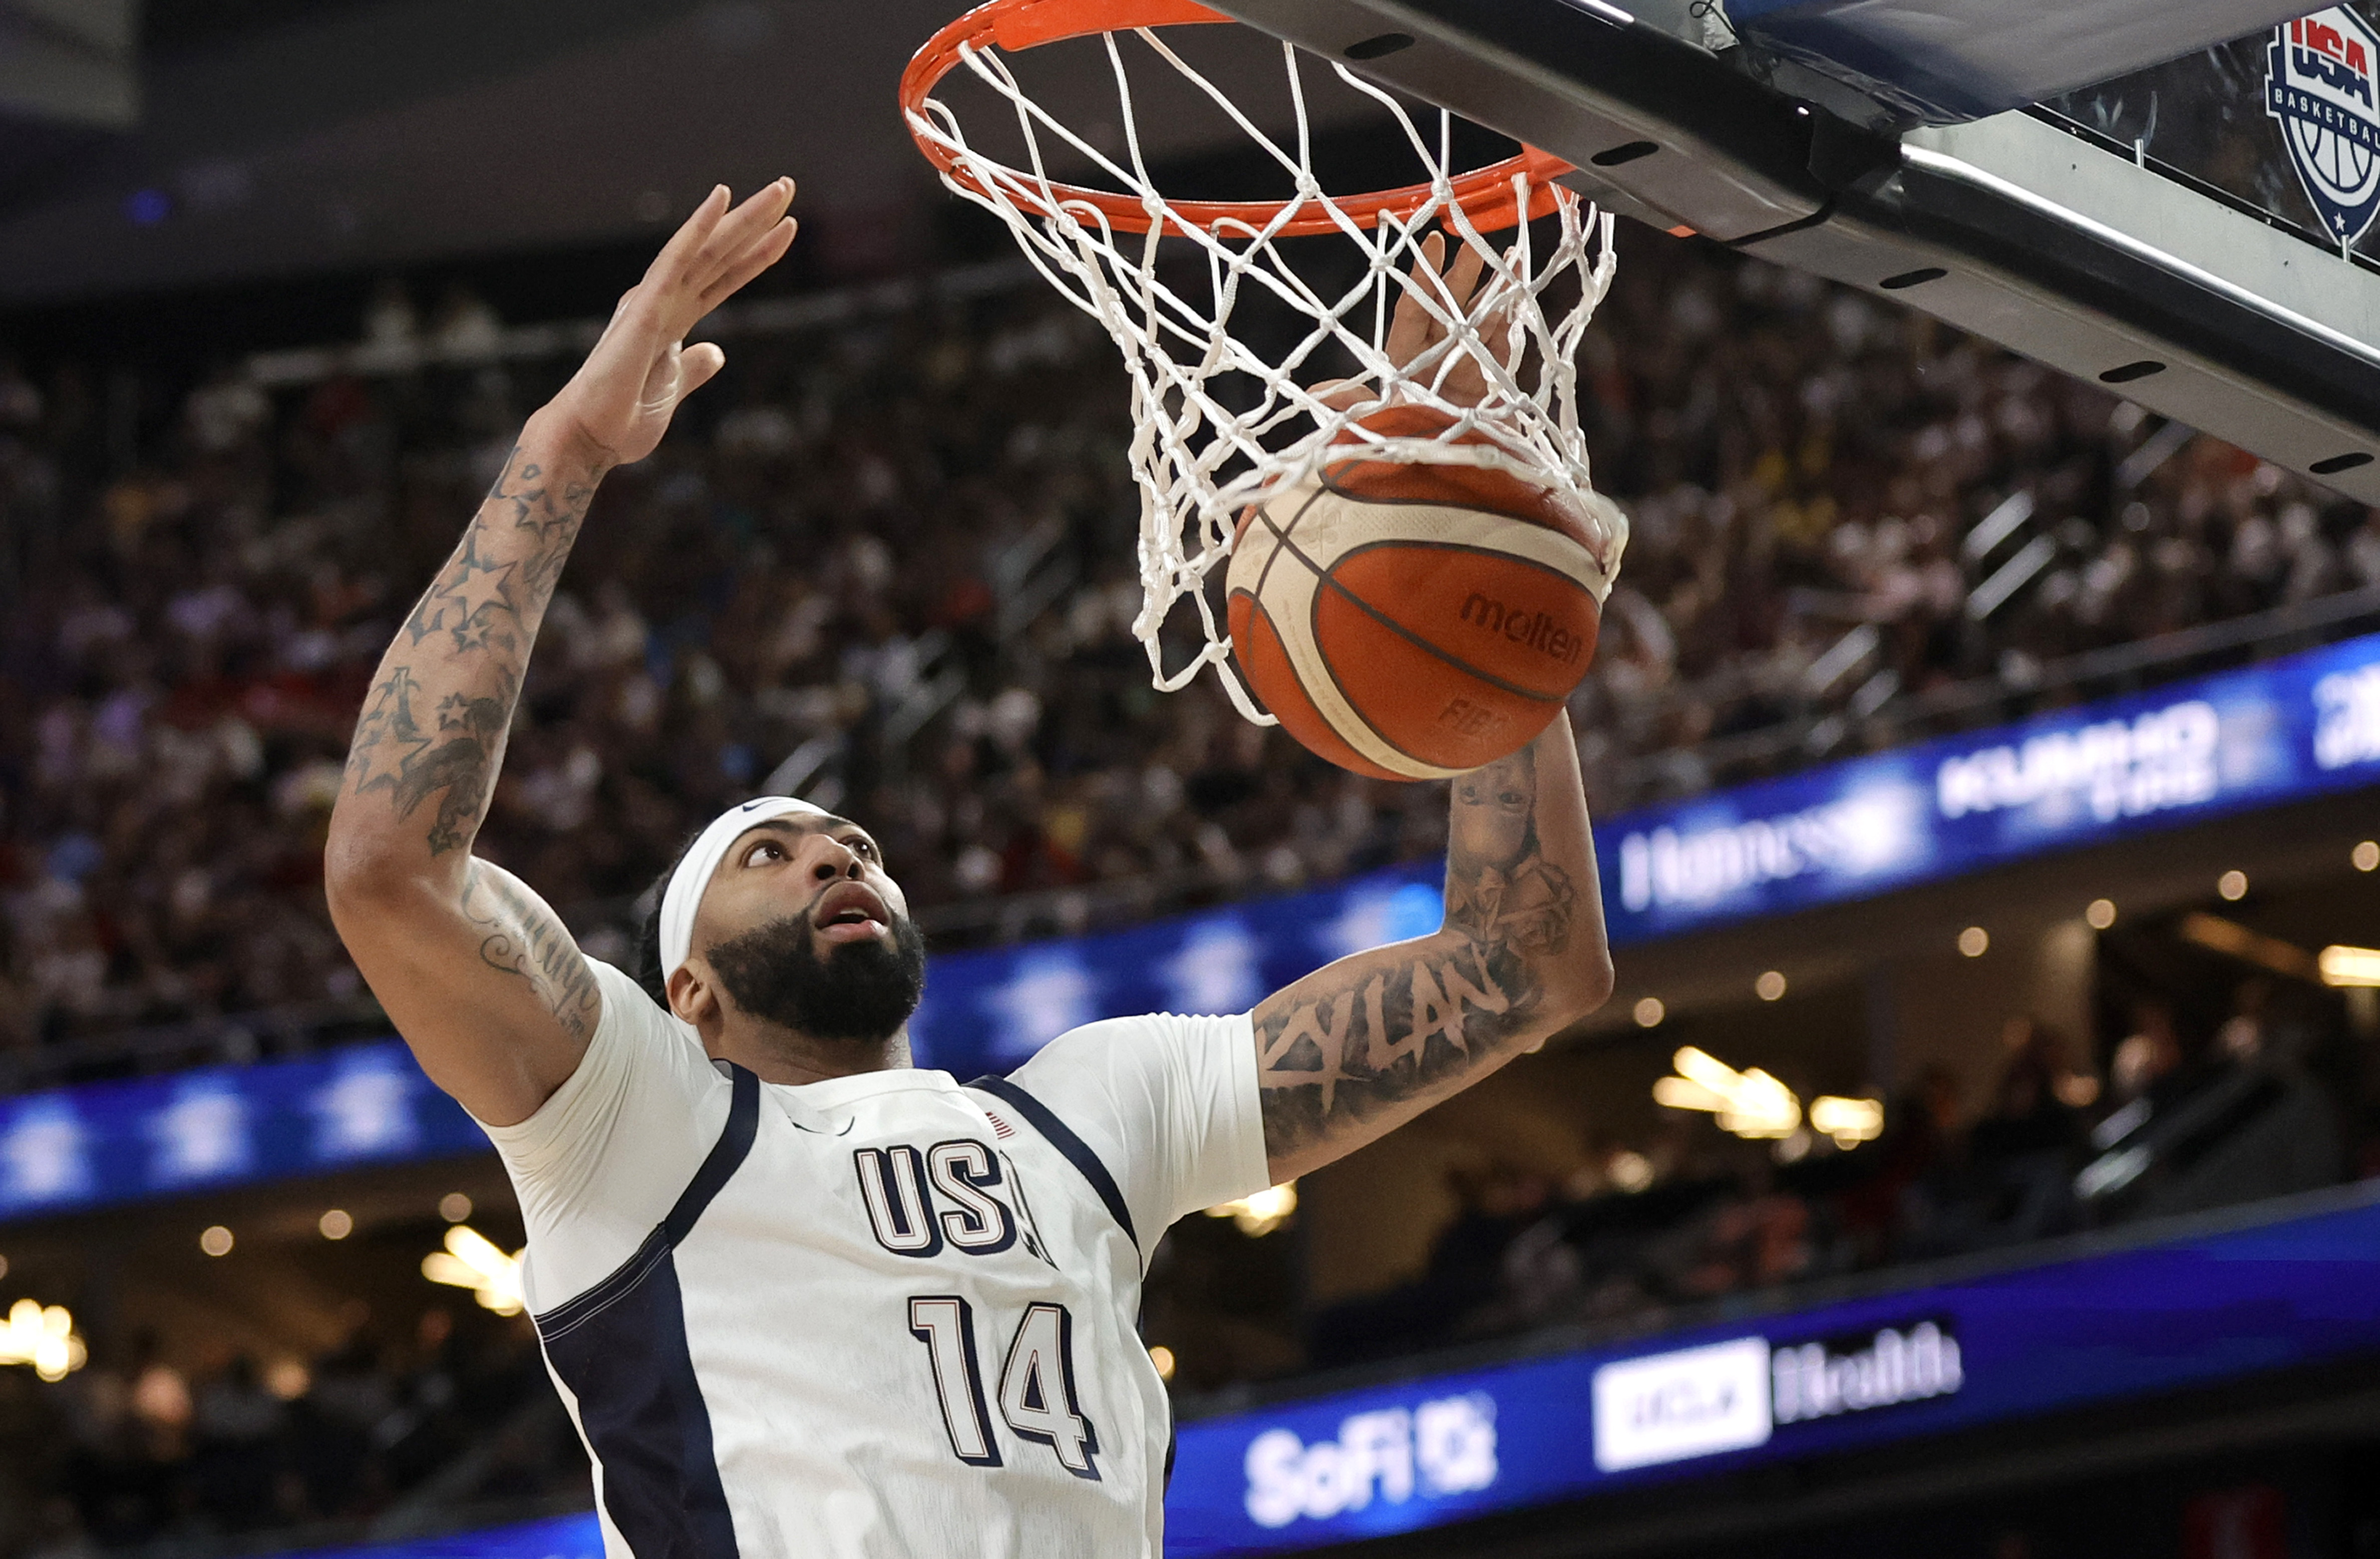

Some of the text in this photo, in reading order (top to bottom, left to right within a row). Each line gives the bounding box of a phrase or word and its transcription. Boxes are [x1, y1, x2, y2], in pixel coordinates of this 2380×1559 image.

[2274, 88, 2380, 149] BASKETBAL
[1459, 592, 1582, 666] molten
[907, 1295, 1102, 1481] 14
